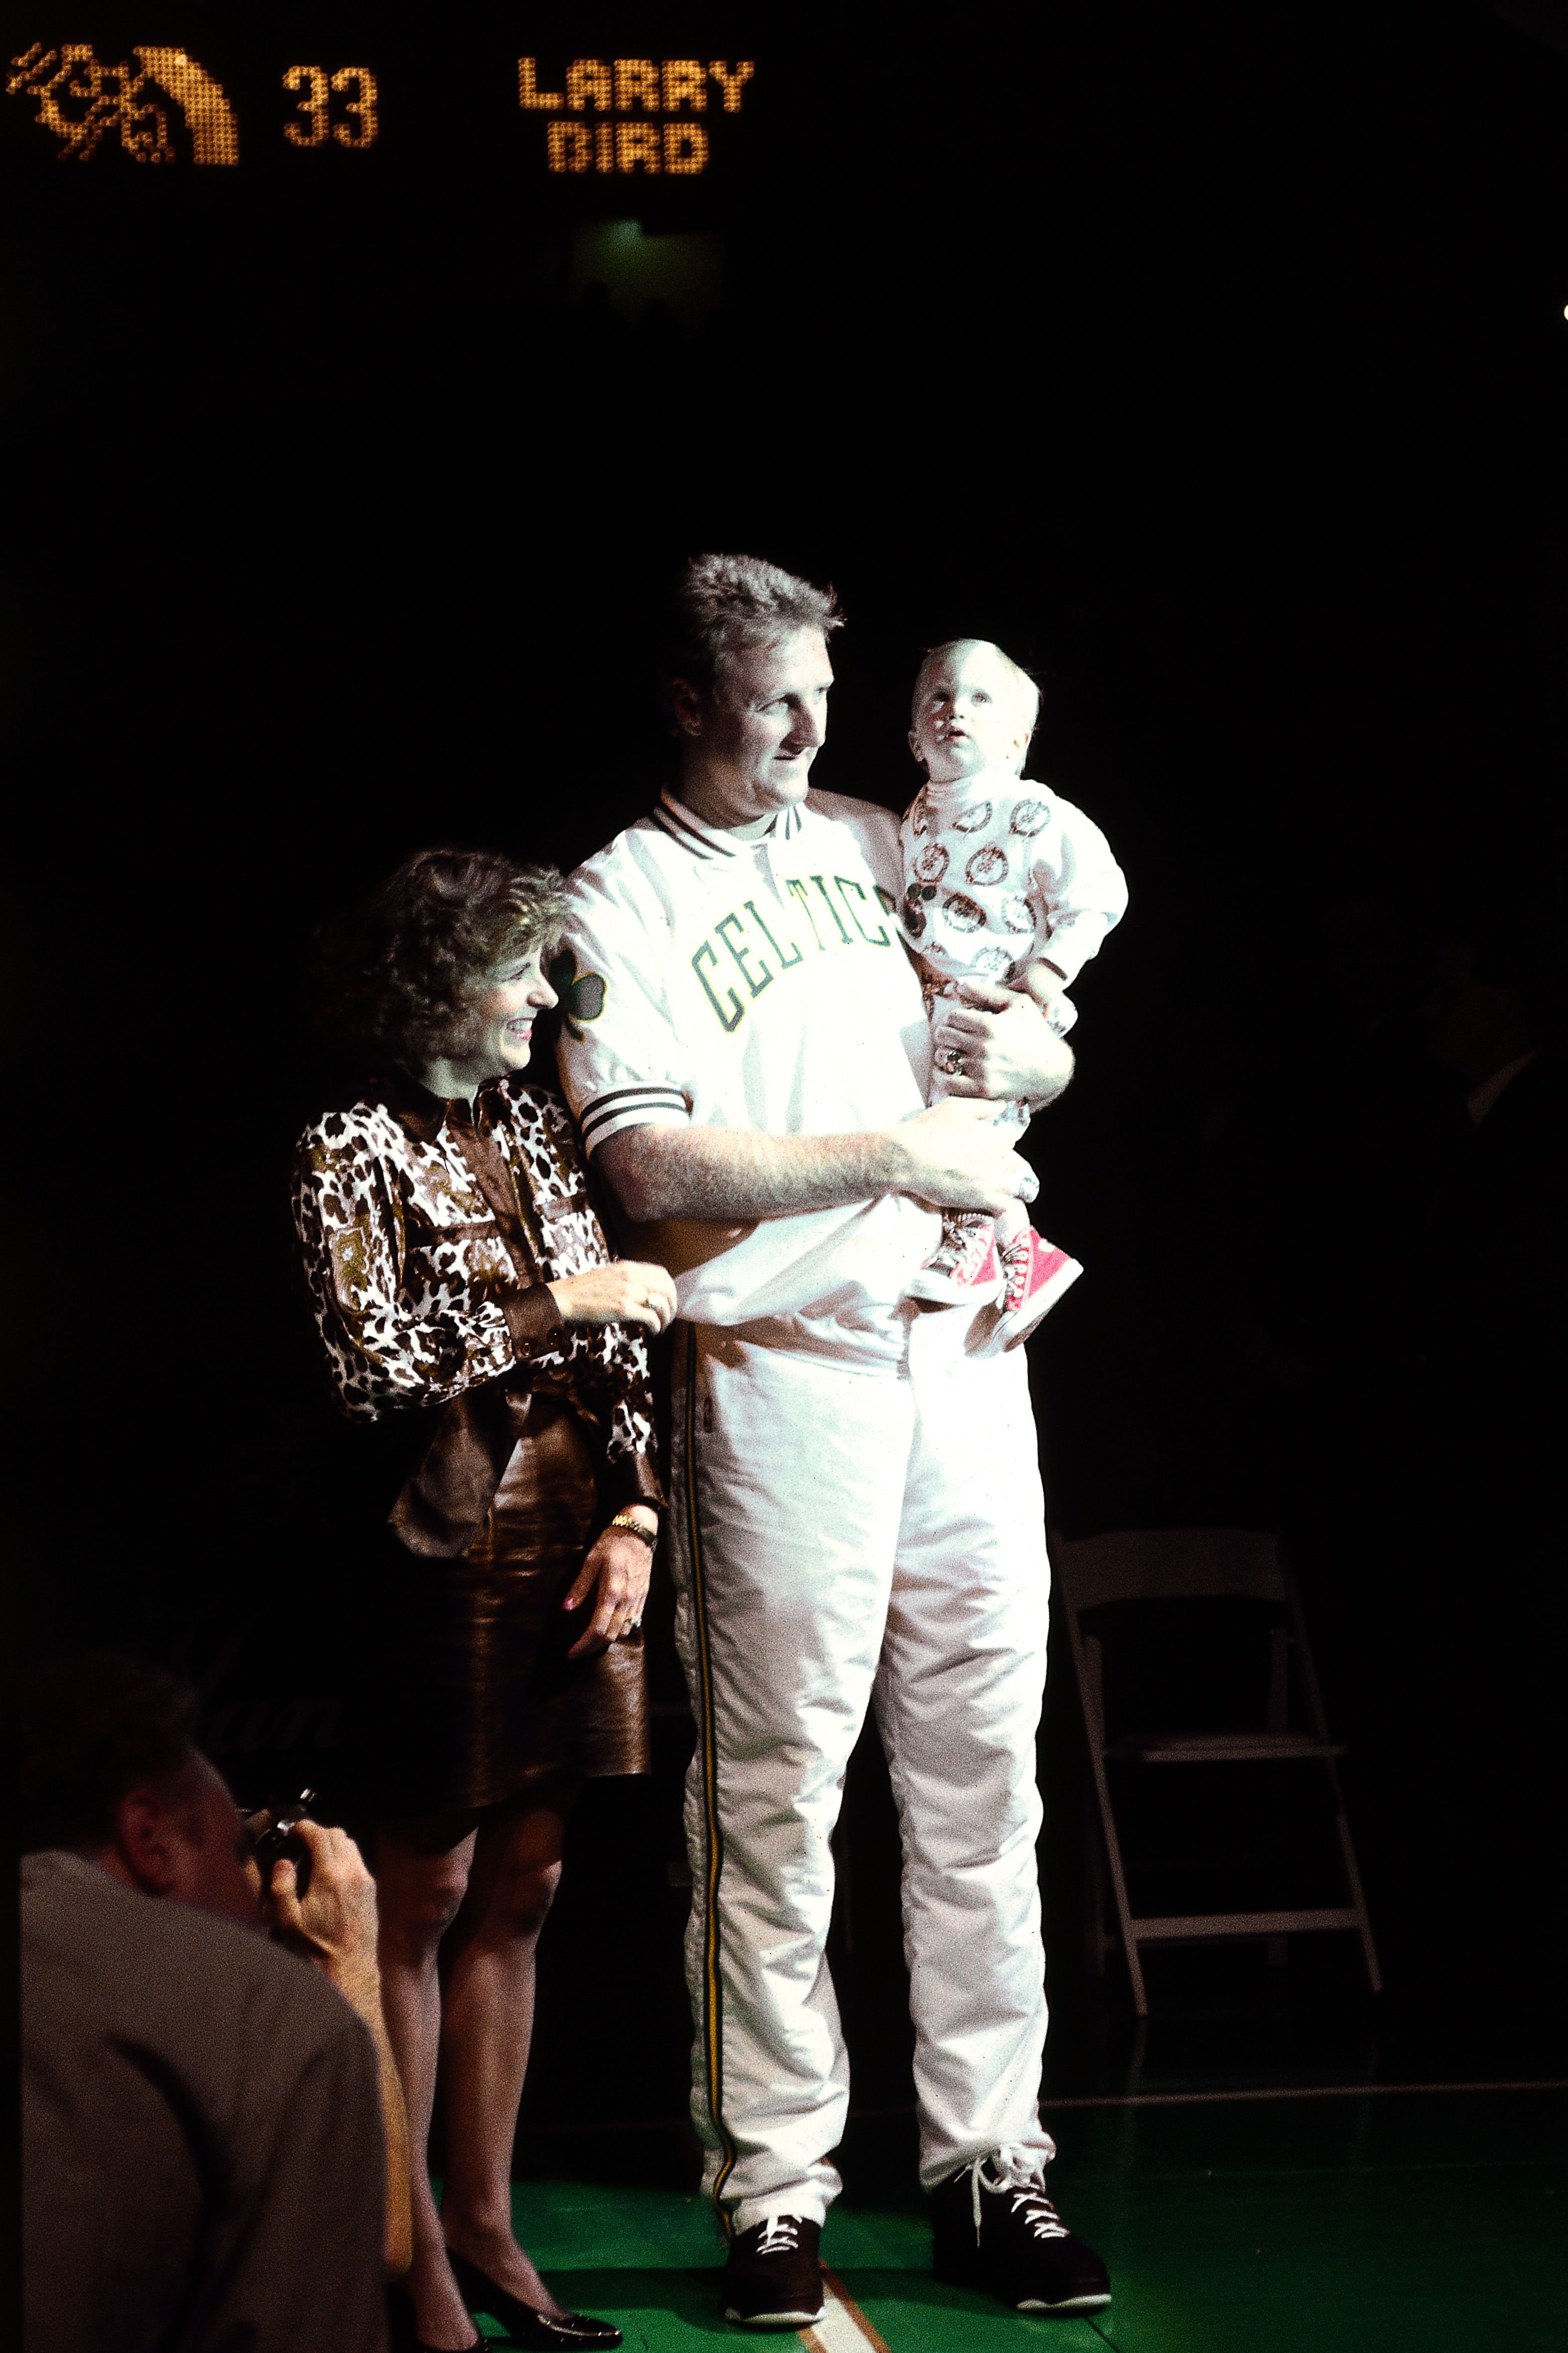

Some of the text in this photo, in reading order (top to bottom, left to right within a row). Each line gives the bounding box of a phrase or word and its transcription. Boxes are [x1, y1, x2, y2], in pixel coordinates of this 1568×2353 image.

[283, 65, 379, 148] 33
[517, 56, 756, 113] LARRY
[547, 120, 710, 175] BIRD
